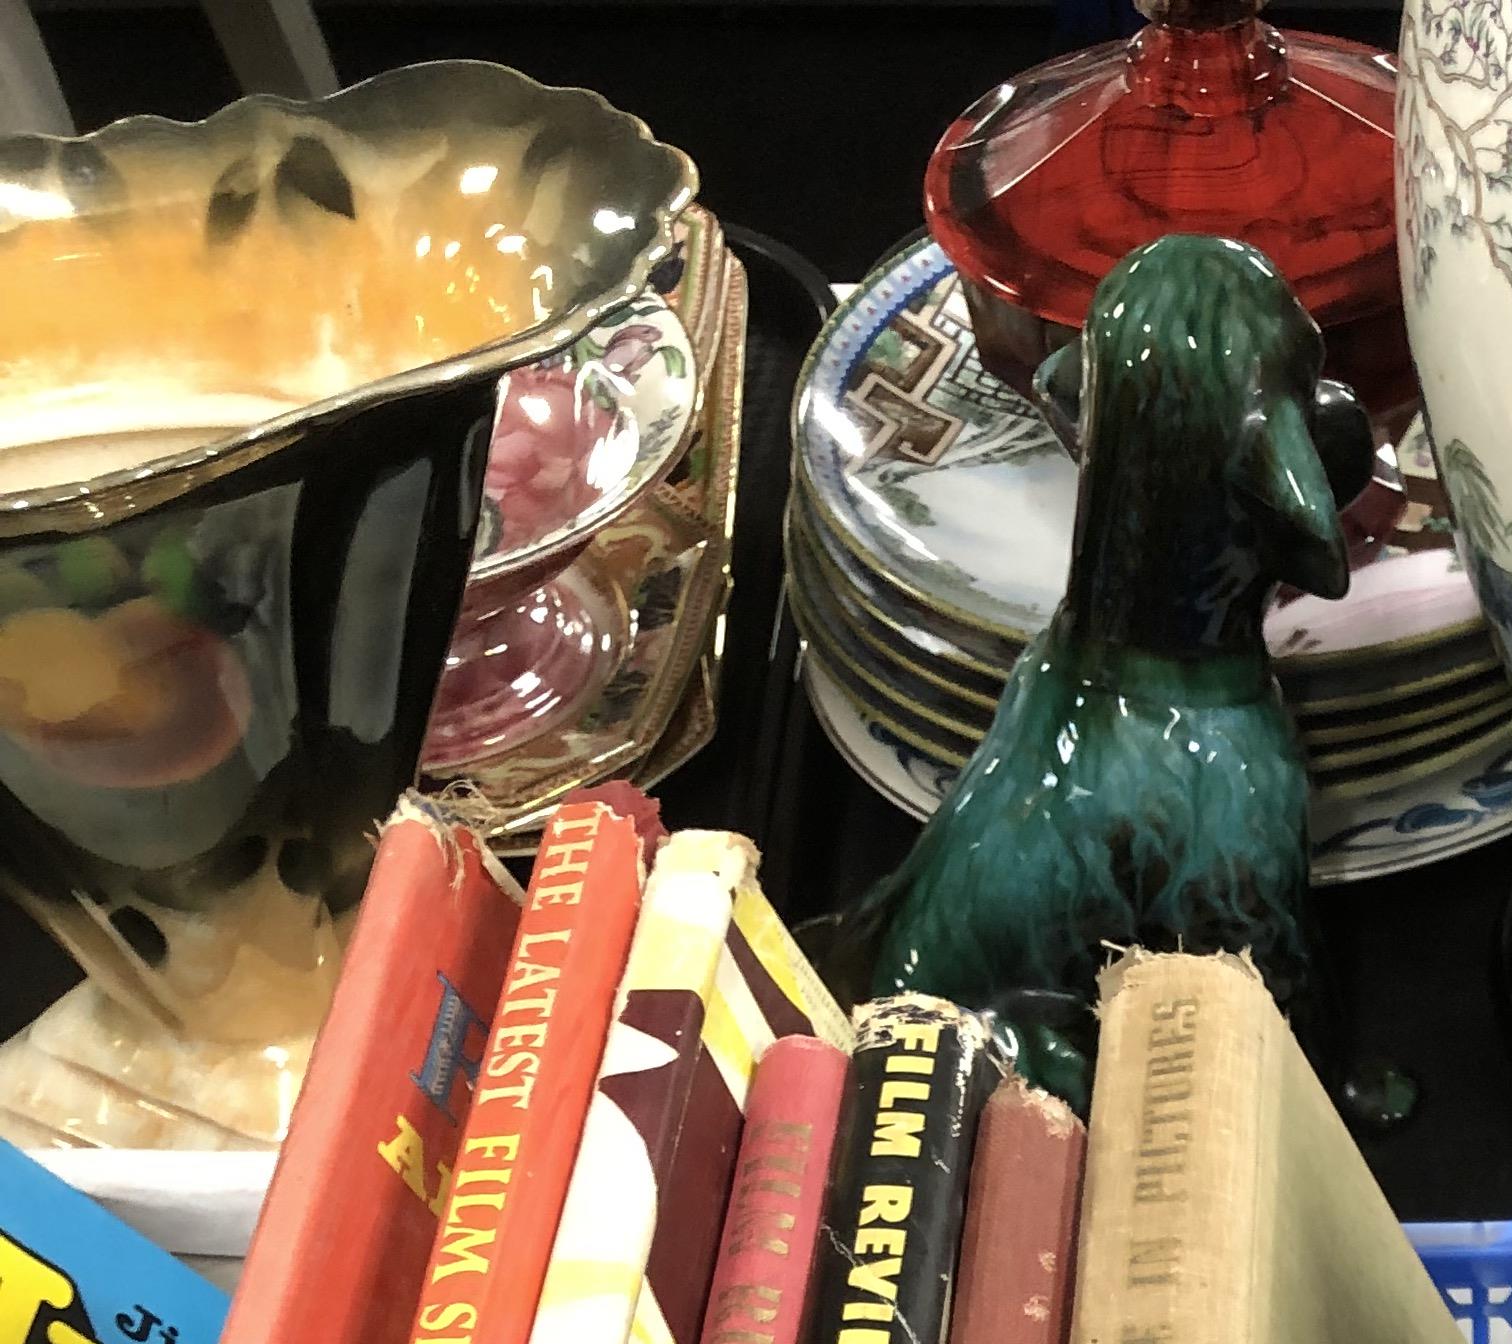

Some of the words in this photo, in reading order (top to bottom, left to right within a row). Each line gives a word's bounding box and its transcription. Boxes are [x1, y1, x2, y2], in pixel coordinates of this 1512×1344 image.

[531, 804, 603, 913] THE
[478, 929, 573, 1110] LATEST
[869, 1018, 941, 1159] FILM
[1133, 997, 1198, 1203] PICTURES
[431, 1132, 521, 1276] FILM
[727, 1122, 813, 1257] FILM
[1127, 1236, 1182, 1289] IN
